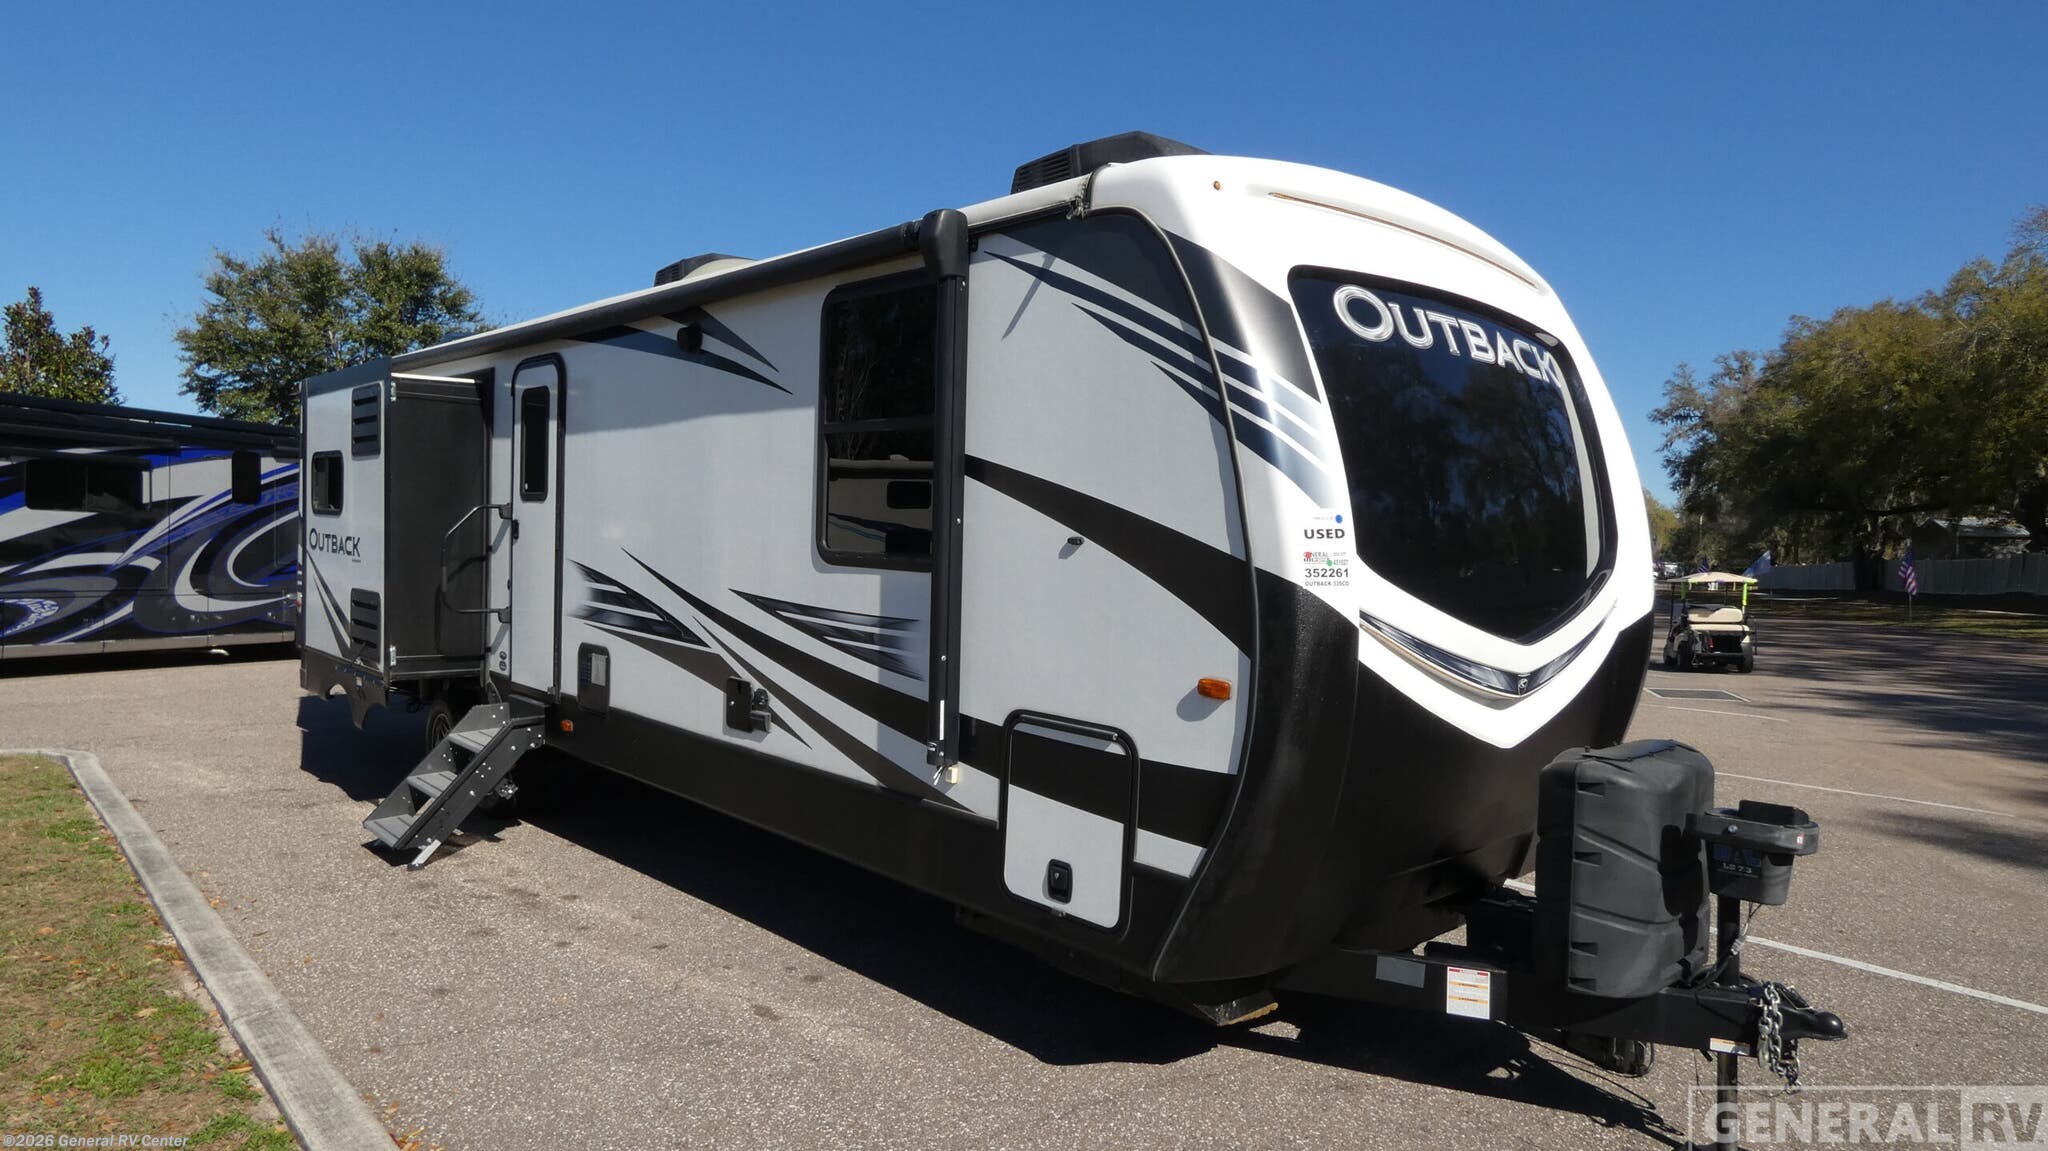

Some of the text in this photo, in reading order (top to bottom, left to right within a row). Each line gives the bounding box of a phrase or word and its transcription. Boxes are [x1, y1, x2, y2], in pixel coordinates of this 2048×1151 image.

[1333, 284, 1562, 388] OUTBACK
[309, 528, 361, 558] OUTBACK
[1304, 528, 1345, 539] USED
[1304, 568, 1349, 578] 352261
